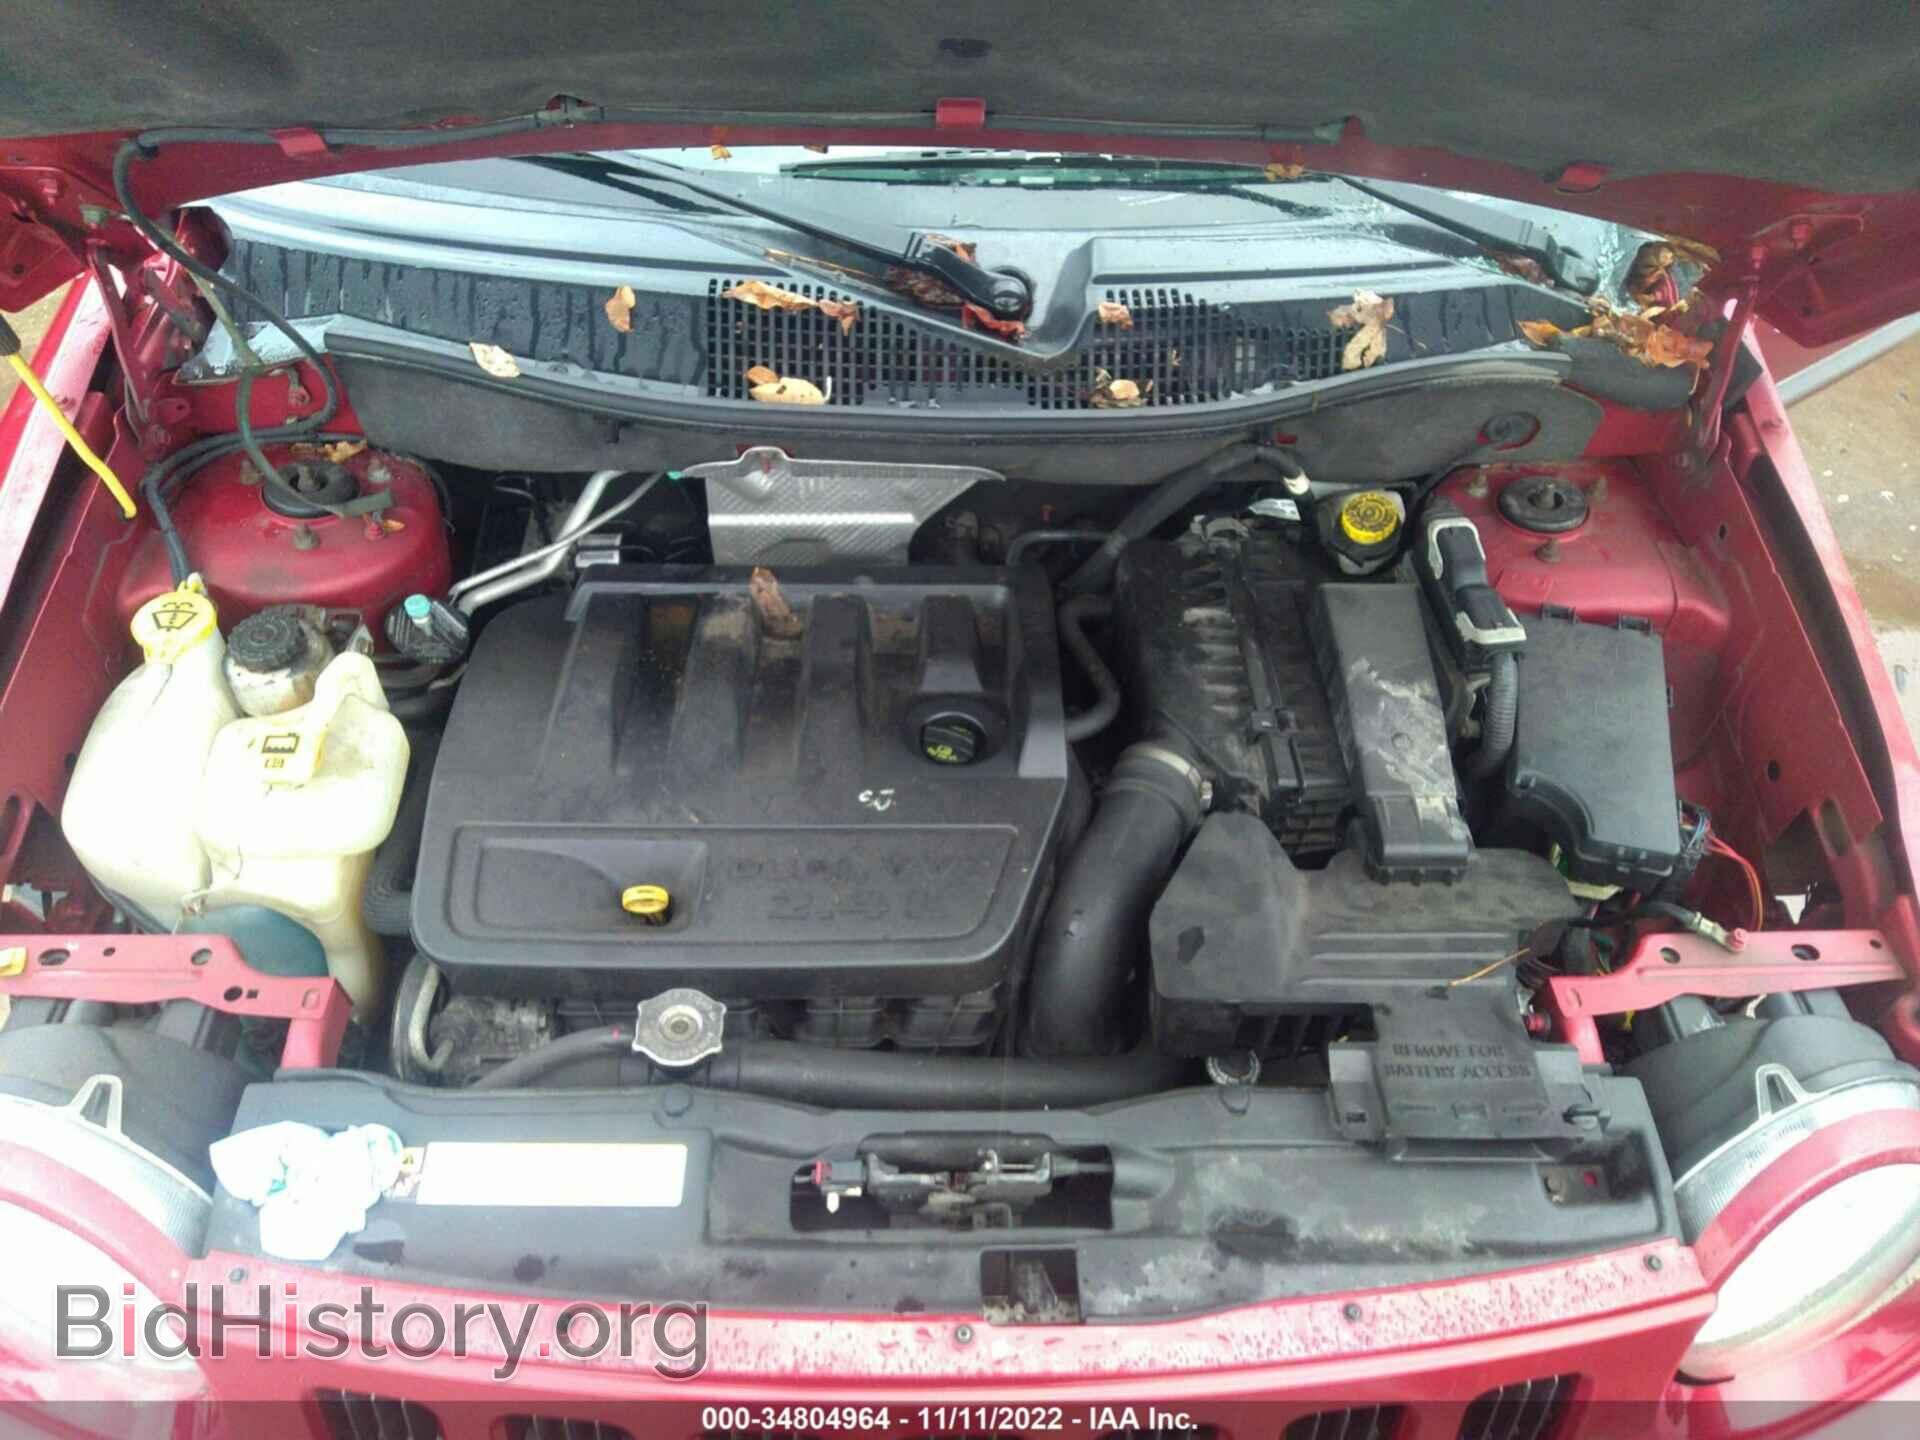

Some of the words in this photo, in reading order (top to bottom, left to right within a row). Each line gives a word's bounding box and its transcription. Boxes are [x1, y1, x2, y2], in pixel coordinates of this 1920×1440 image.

[1392, 1042, 1461, 1058] REMOVE
[1467, 1042, 1504, 1057] FOR
[1384, 1063, 1455, 1079] BATTERY
[1461, 1063, 1533, 1079] ACCESS
